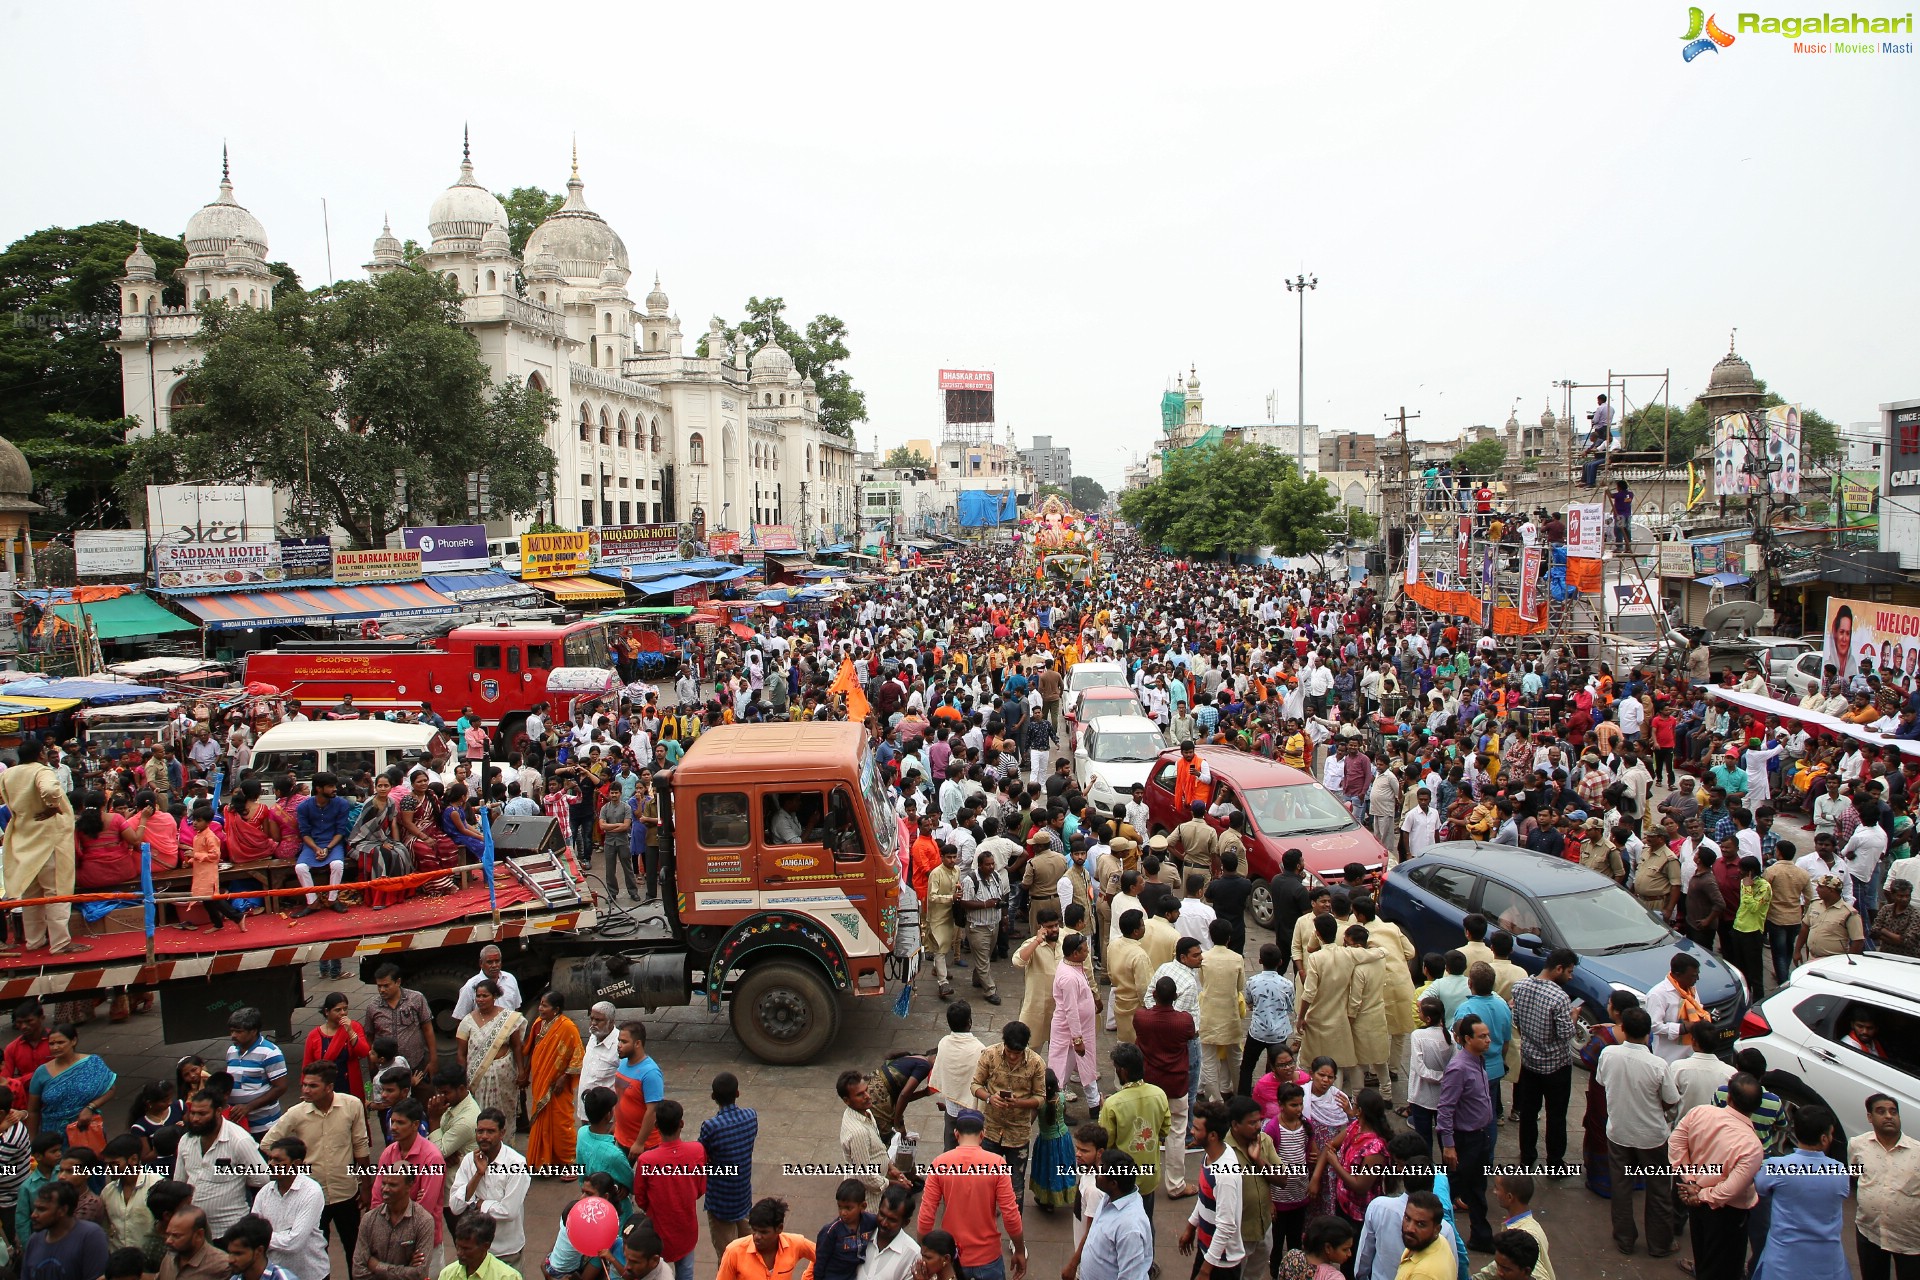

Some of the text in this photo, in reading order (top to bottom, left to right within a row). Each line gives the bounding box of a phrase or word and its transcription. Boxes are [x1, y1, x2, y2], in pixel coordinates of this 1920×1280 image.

[943, 371, 991, 381] BHASKAR ARTS
[1898, 413, 1917, 422] SINCE
[602, 527, 677, 542] MUQADDAR HOTEL
[438, 538, 474, 548] PhonePe
[527, 535, 584, 552] MUNNU
[170, 547, 226, 559] SADDAM
[229, 546, 269, 557] HOTEL
[337, 554, 356, 564] ABUL
[358, 552, 392, 563] BARKAAT
[393, 551, 419, 562] BAKERY
[536, 552, 577, 562] PAN SHOP
[1876, 611, 1920, 637] WELCO
[780, 858, 814, 867] JANGAIAH
[597, 980, 630, 996] DIESEL
[610, 986, 636, 999] TANK
[206, 1000, 245, 1012] TOOL BOX
